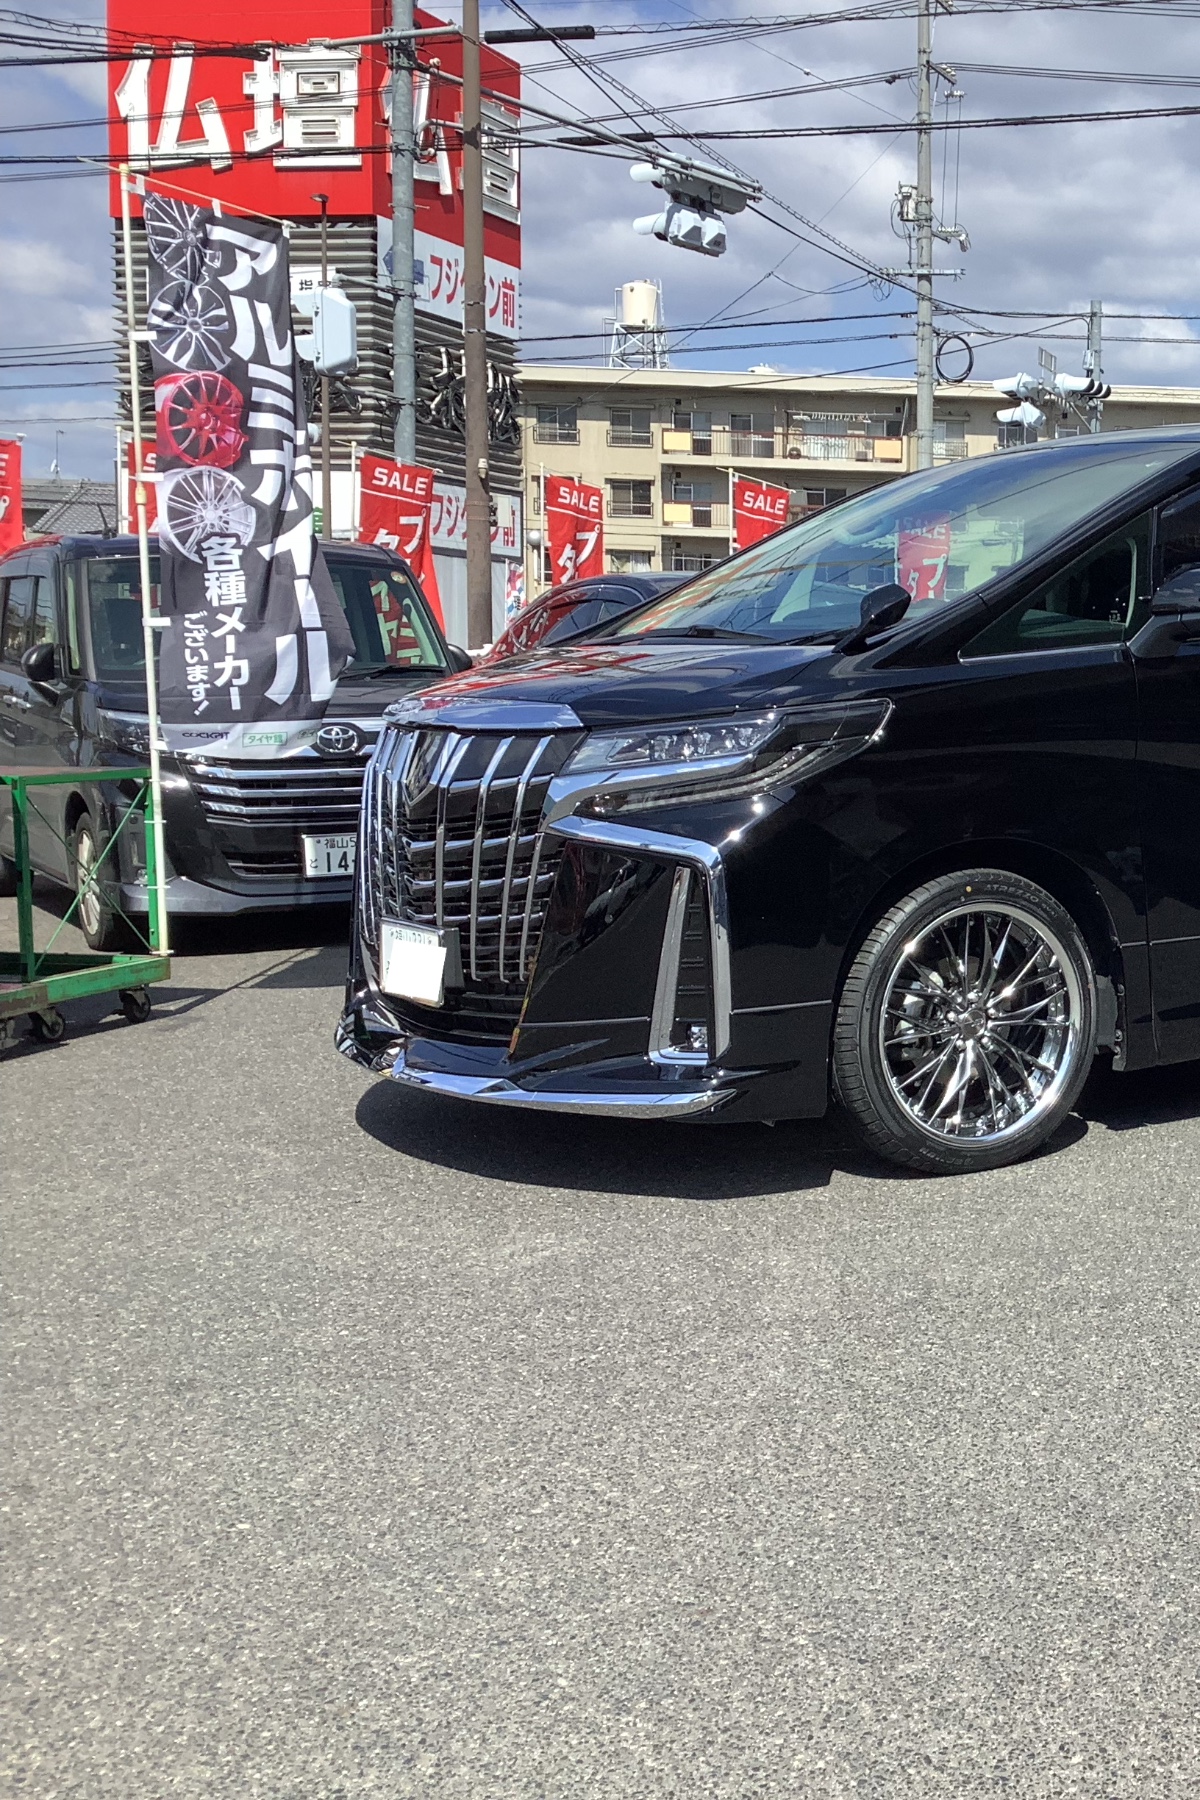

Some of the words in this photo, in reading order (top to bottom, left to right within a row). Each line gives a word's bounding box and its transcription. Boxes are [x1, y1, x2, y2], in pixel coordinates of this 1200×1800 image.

[430, 254, 516, 329] フジン前
[372, 466, 429, 496] SALE
[557, 486, 600, 513] SALE
[743, 491, 787, 515] SALE
[201, 535, 250, 710] 各種メーカー
[184, 610, 211, 716] ございます!
[247, 733, 283, 744] タイヤ館
